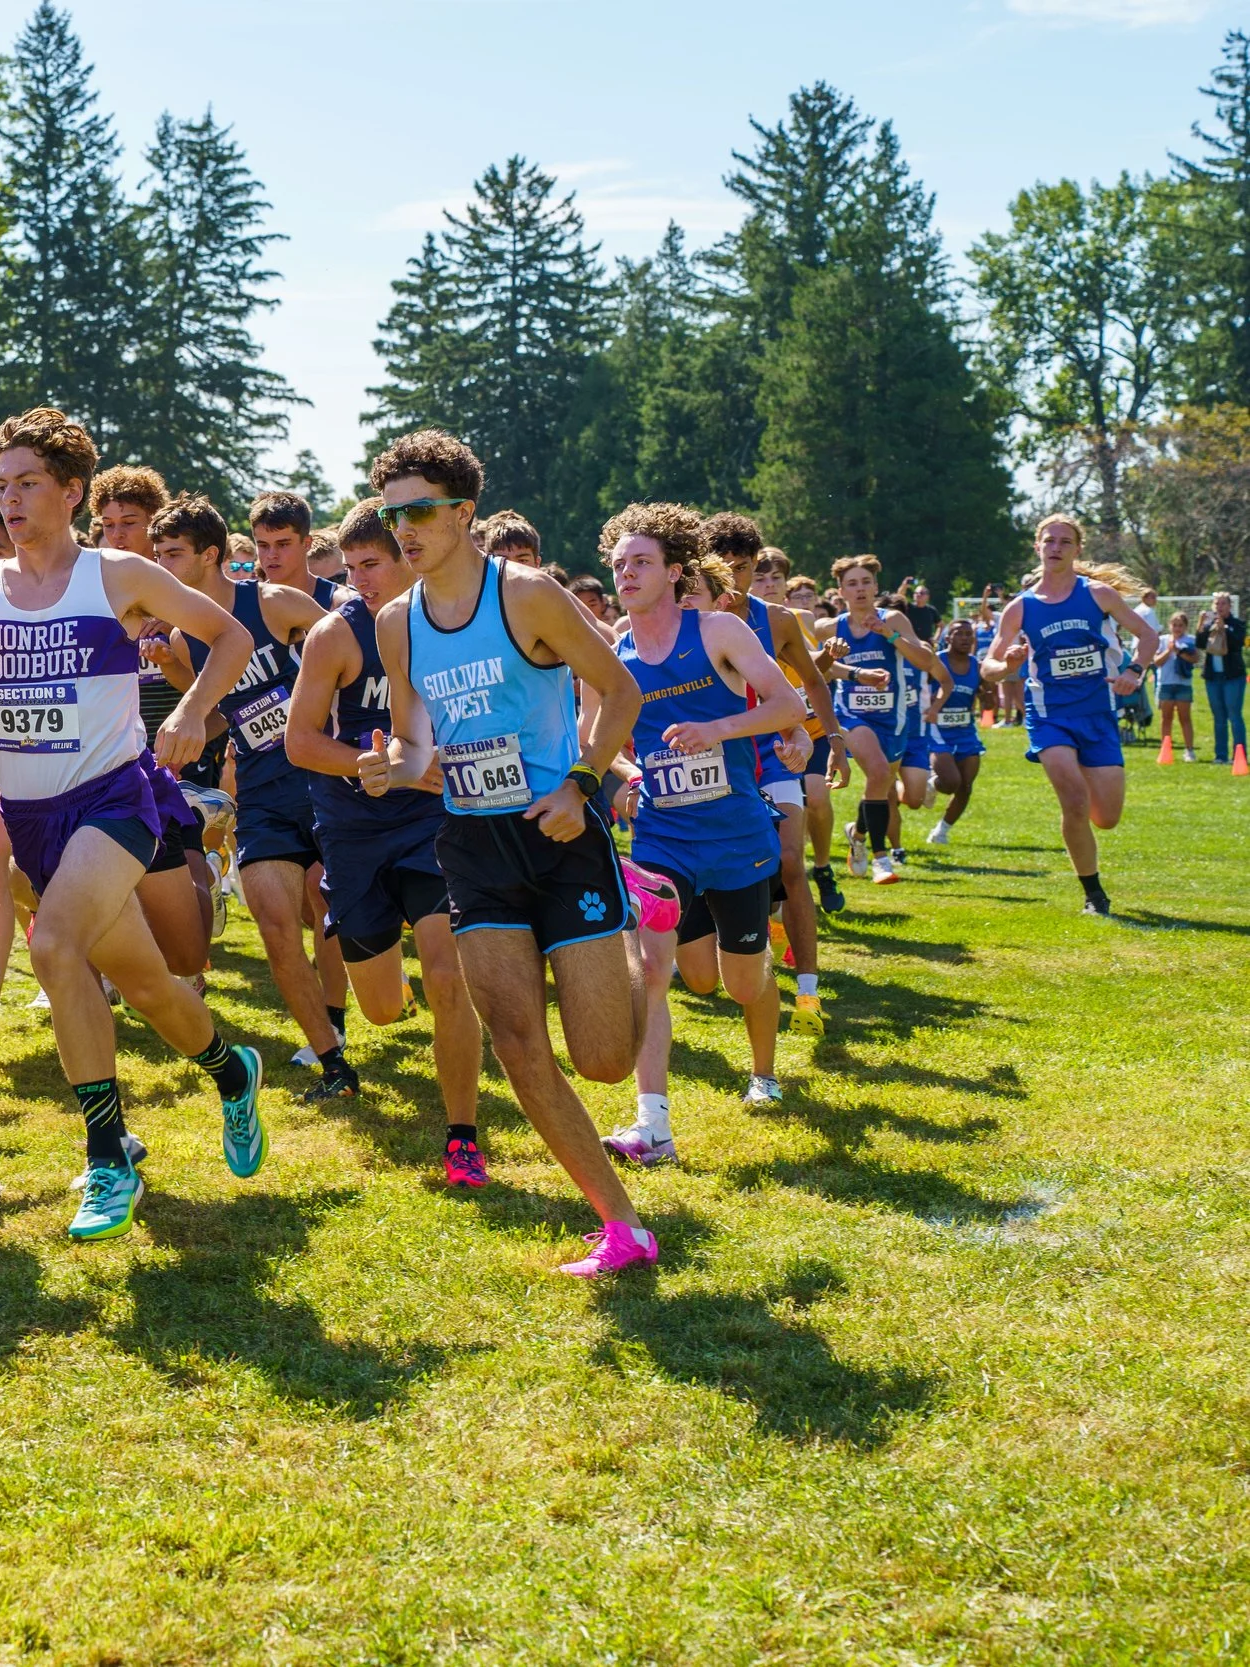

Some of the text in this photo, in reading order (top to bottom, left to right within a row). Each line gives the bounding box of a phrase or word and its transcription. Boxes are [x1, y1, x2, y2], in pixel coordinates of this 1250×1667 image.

[1059, 655, 1094, 671] 9525
[423, 657, 504, 700] SULLIVAN
[56, 687, 66, 698] 9
[239, 695, 272, 719] SECTION
[270, 691, 280, 701] 9
[361, 676, 391, 710] M
[856, 695, 886, 706] 9535
[443, 689, 492, 723] WEST
[0, 708, 63, 733] 9379
[249, 707, 288, 739] 9433
[444, 737, 507, 755] SECTION 9
[446, 748, 509, 762] X-COUNTRY
[448, 764, 521, 796] 10 643
[653, 765, 719, 795] 10 677
[490, 796, 511, 806] Accurate
[78, 1082, 110, 1094] cep
